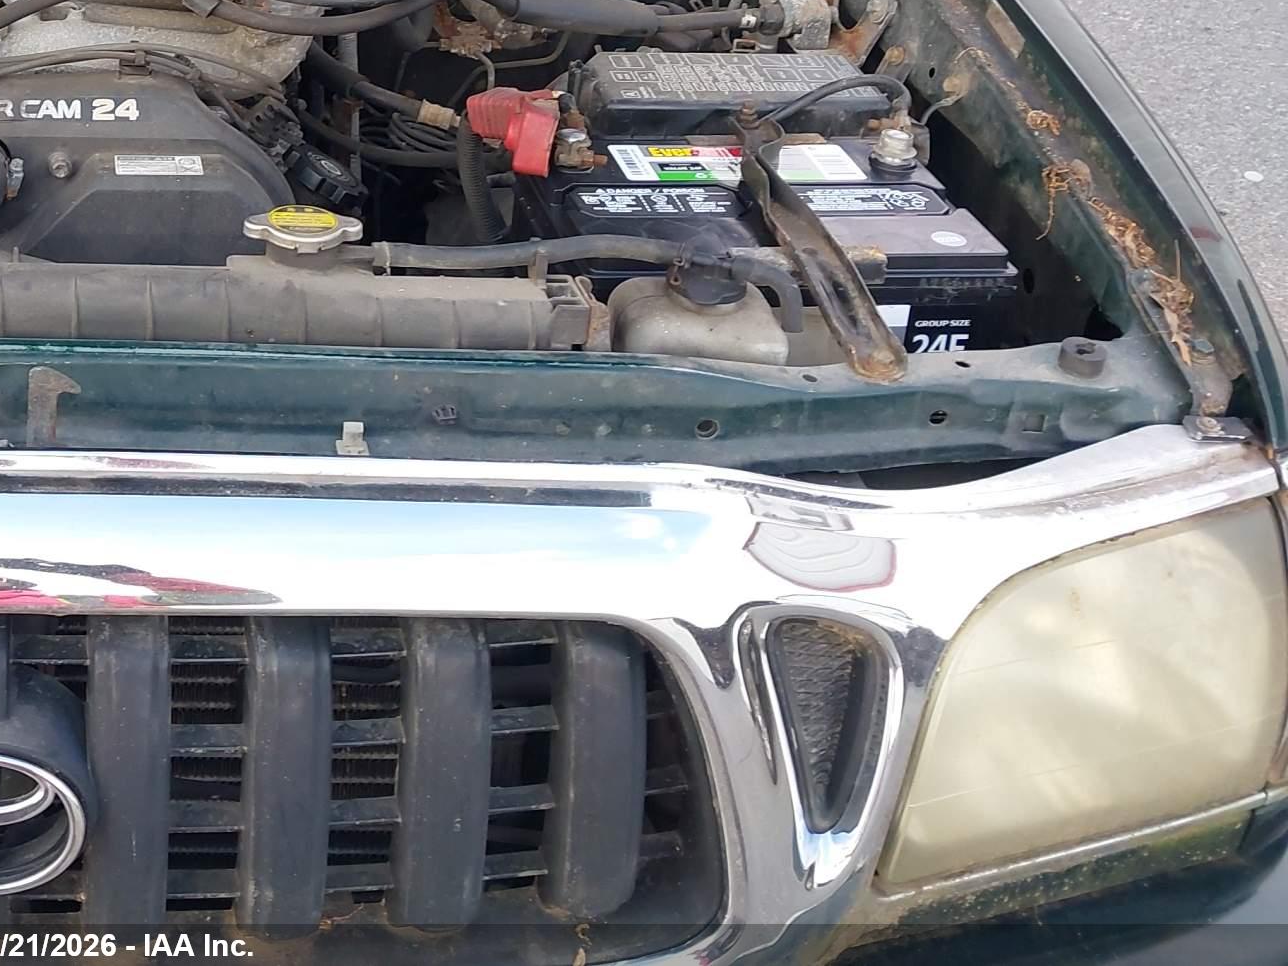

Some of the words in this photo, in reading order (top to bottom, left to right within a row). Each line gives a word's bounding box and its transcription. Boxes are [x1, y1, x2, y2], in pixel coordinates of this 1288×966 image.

[20, 99, 82, 120] CAM
[92, 98, 139, 121] 24
[915, 319, 949, 328] GROUP
[950, 319, 972, 327] SIZE
